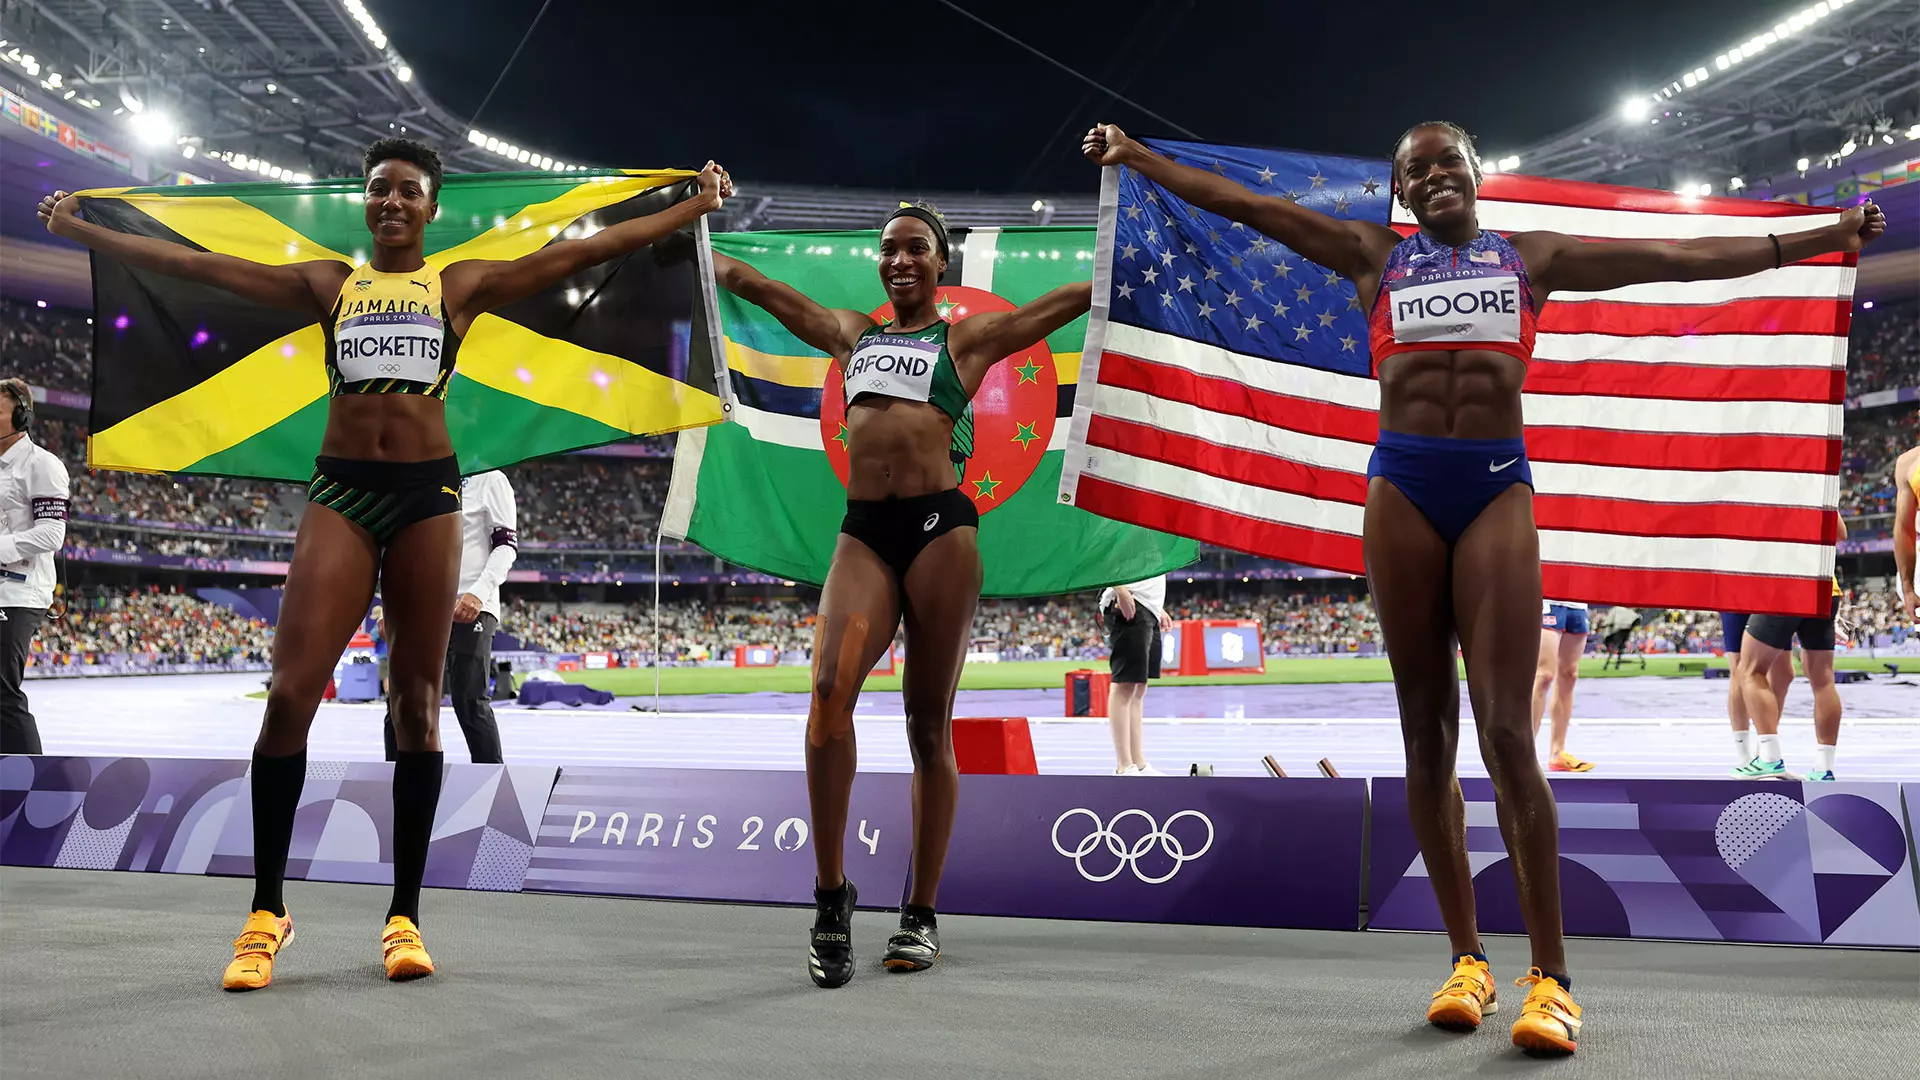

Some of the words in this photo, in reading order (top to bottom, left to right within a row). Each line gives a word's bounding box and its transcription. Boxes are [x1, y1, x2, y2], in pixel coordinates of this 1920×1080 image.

[343, 299, 431, 318] JAMAICA
[1398, 289, 1516, 322] MOORE
[363, 315, 391, 323] PARIS
[340, 335, 440, 361] RICKETTS
[892, 338, 916, 346] 2024
[846, 354, 929, 381] LAFOND
[736, 815, 881, 855] 204
[815, 932, 847, 942] ADIZERO
